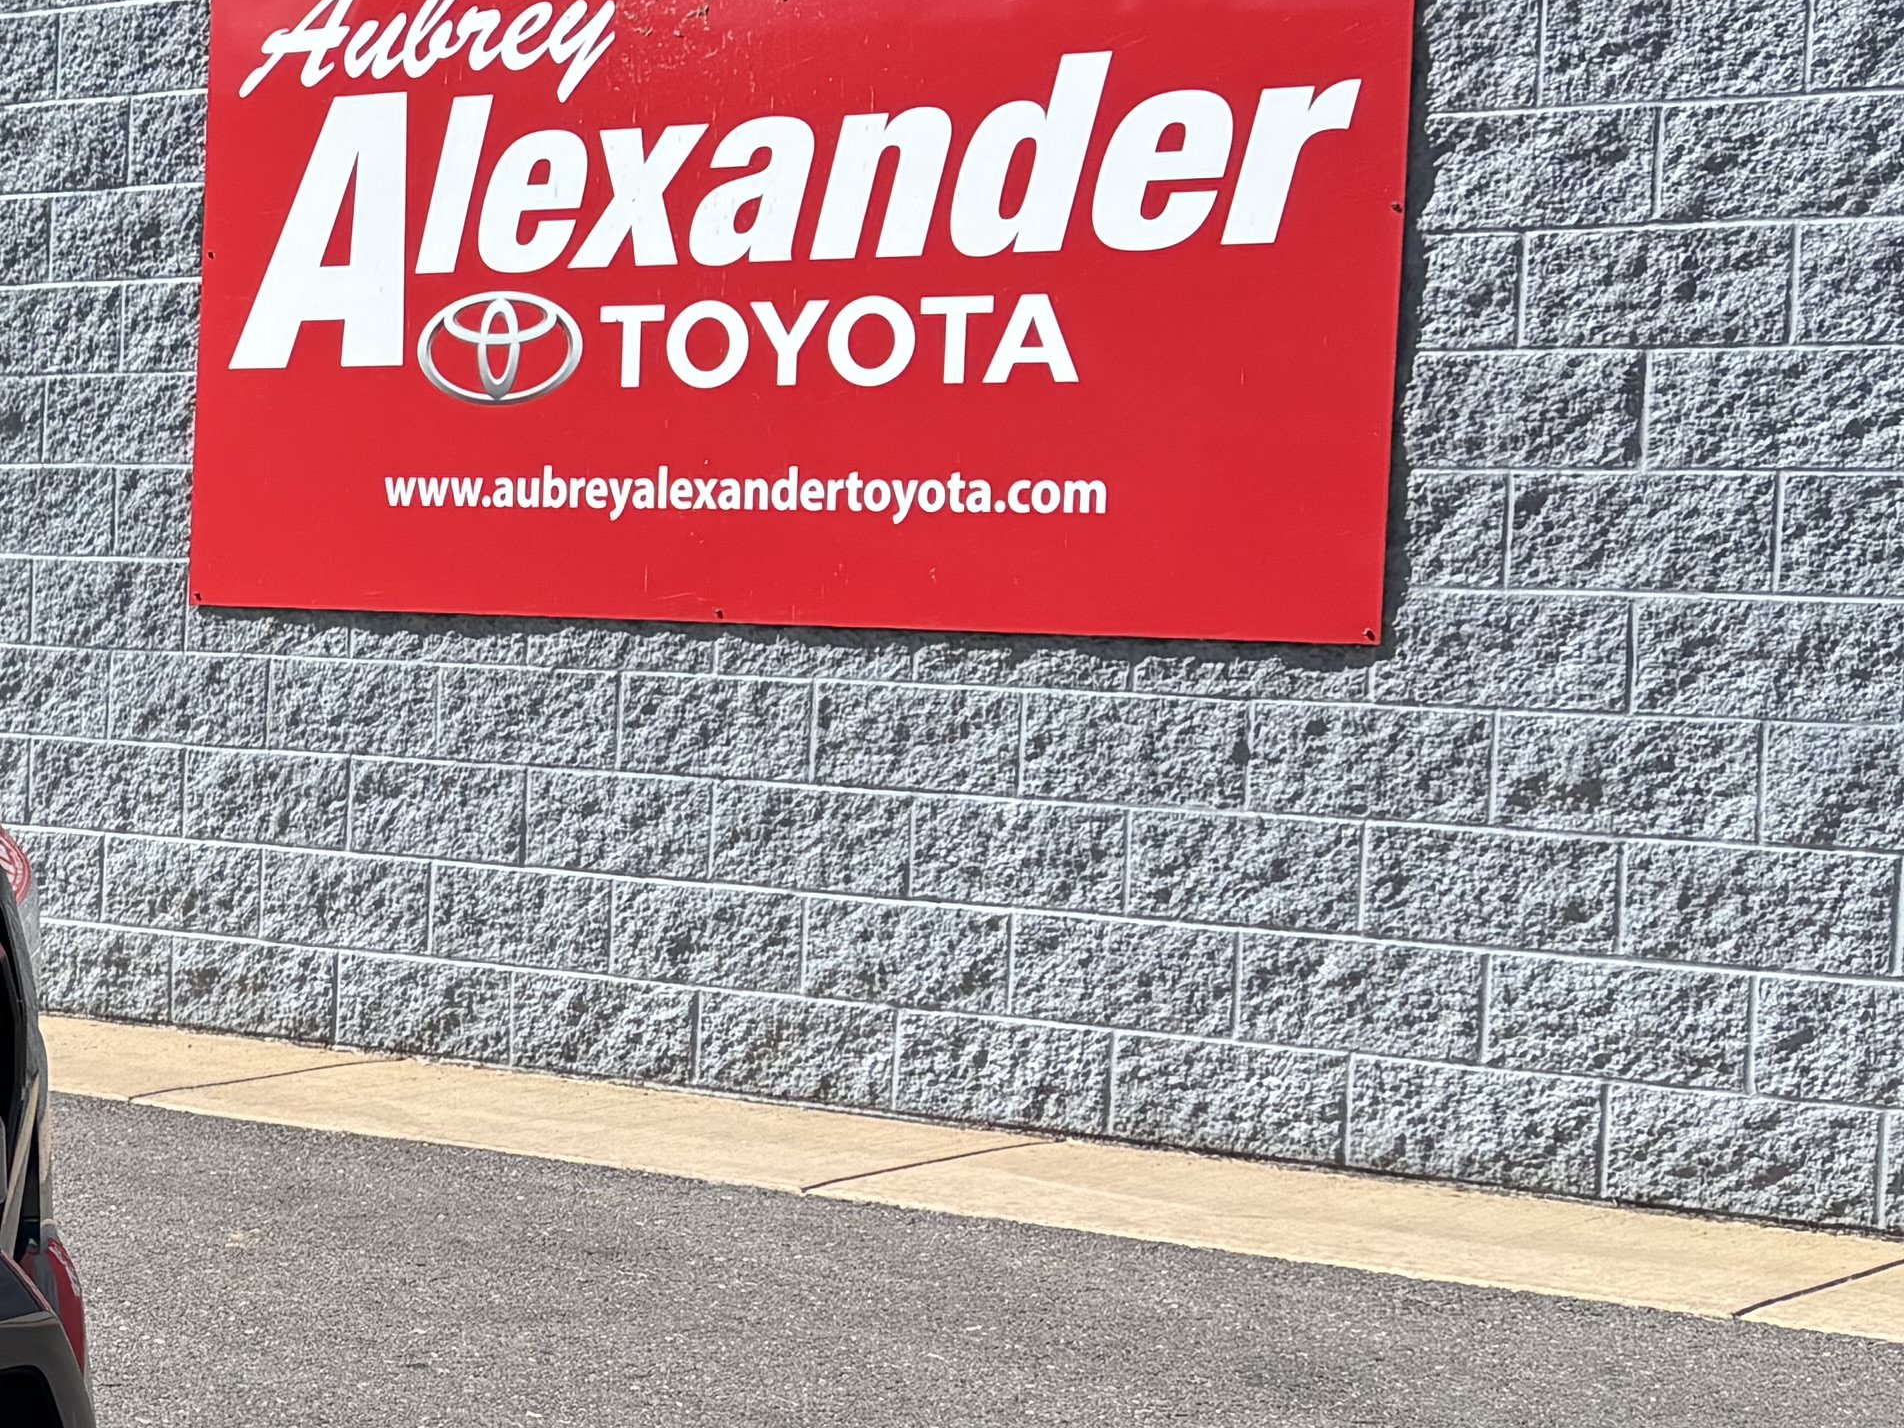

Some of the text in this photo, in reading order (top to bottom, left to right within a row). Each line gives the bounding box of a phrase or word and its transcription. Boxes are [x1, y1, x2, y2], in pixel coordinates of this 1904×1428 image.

[228, 50, 1362, 370] Alexander
[599, 293, 1079, 389] TOYOTA
[384, 465, 1107, 525] www.aubreyalexandertoyota.com
